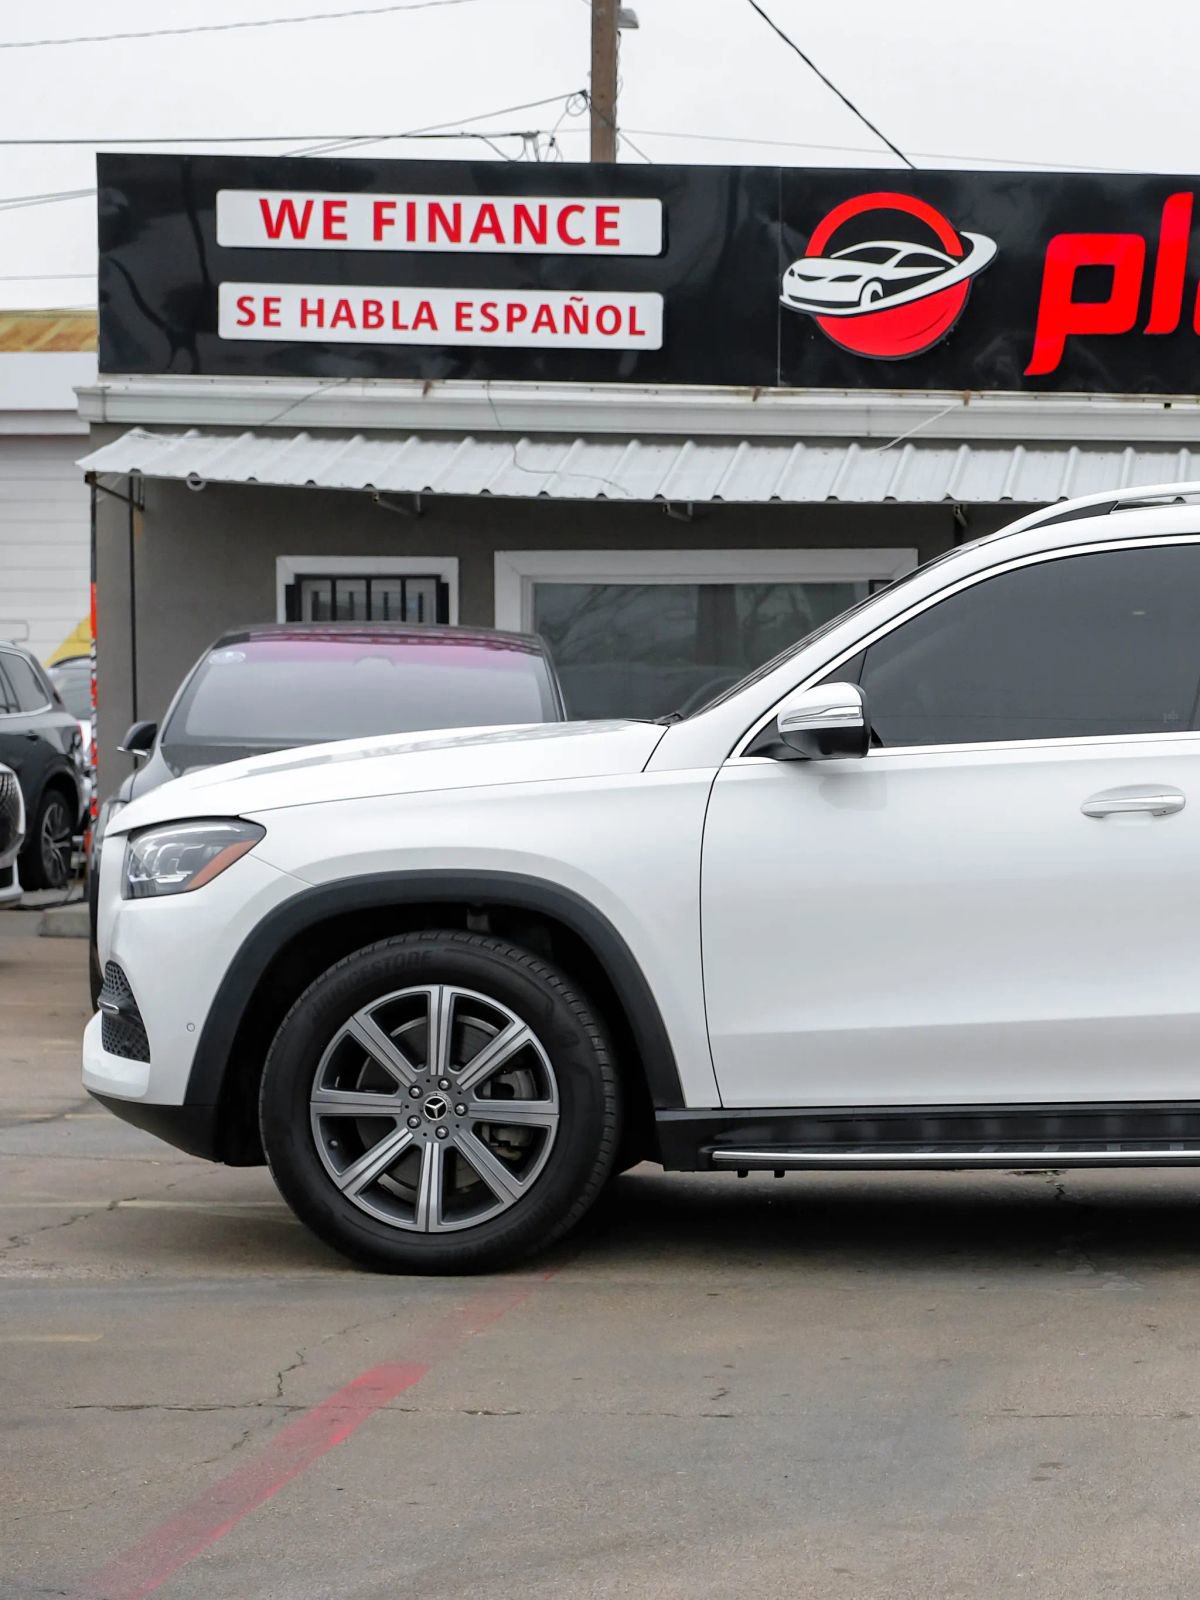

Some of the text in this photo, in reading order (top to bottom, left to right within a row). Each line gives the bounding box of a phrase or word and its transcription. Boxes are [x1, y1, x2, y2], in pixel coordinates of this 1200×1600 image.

[260, 198, 620, 247] WE FINANCE
[237, 295, 645, 337] SE HABLA ESPAÑOL
